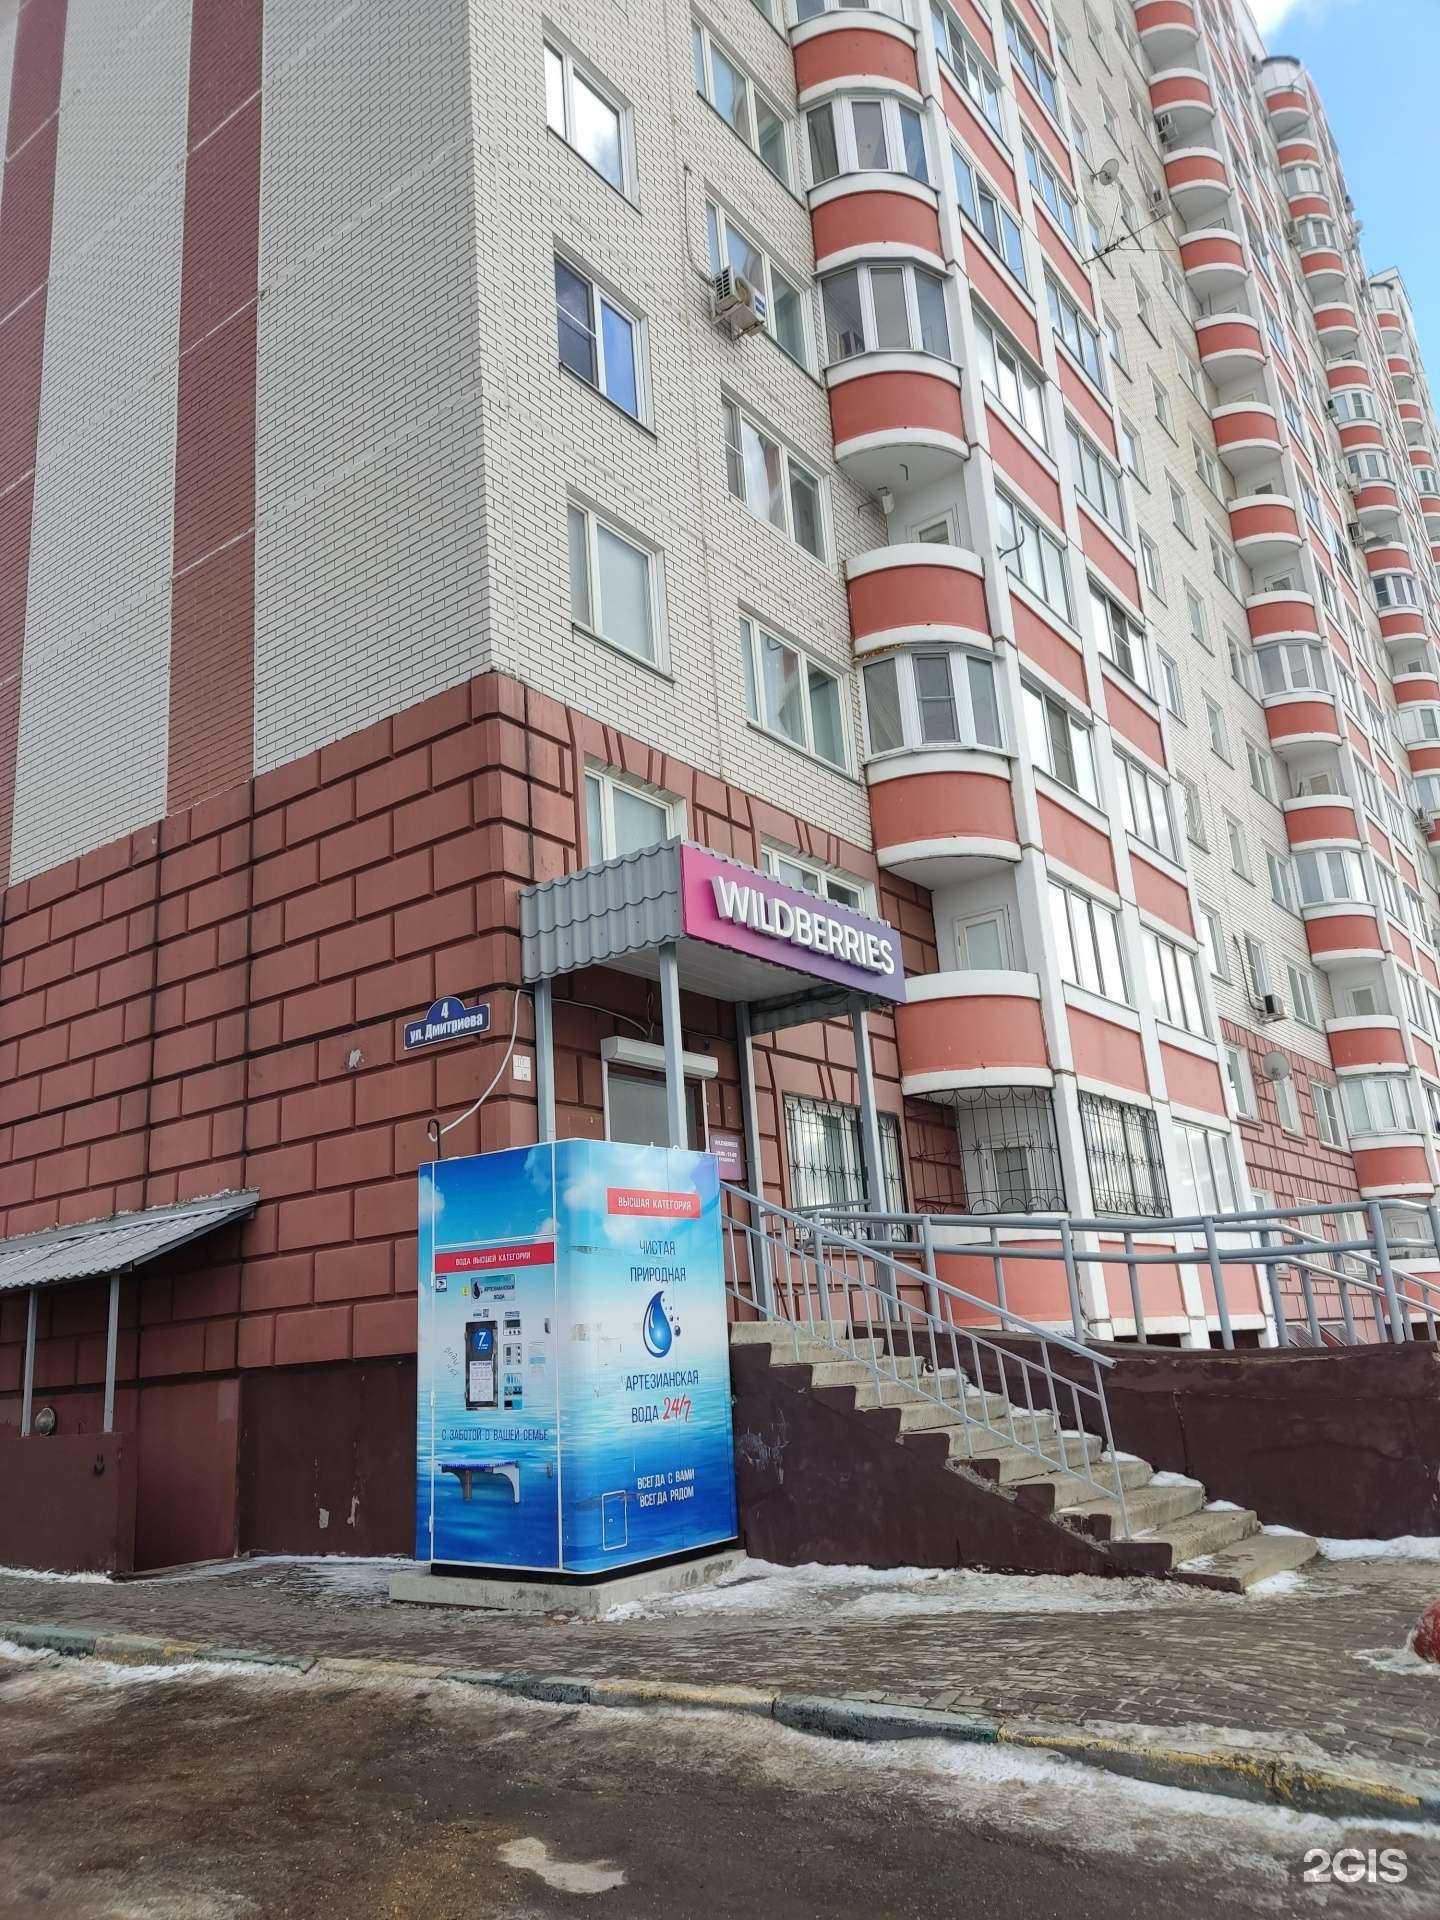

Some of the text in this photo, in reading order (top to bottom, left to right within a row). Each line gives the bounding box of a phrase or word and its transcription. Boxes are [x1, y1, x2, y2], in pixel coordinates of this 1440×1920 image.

[710, 876, 895, 975] WILDBERRIES
[441, 1002, 449, 1018] 4
[410, 1013, 483, 1043] ул. Дмитриева
[618, 1196, 692, 1211] ВЫСШАЯ КАТЕГОРИЯ
[640, 1240, 676, 1256] ЧИСТАЯ
[455, 1258, 471, 1266] ВОДА
[630, 1266, 687, 1283] ПРИРОДНАЯ
[626, 1369, 699, 1391] АРТЕЗИАНСКАЯ
[631, 1393, 691, 1423] ВОДА 24/7
[442, 1429, 447, 1440] С
[450, 1427, 482, 1440] ЗАБОТОЙ
[494, 1427, 520, 1440] ВАШЕЙ
[524, 1428, 549, 1440] СЕМЬЕ
[637, 1468, 695, 1489] ВСЕГДА С ВАМИ
[640, 1486, 694, 1508] ВСЕГДА РЯДОМ
